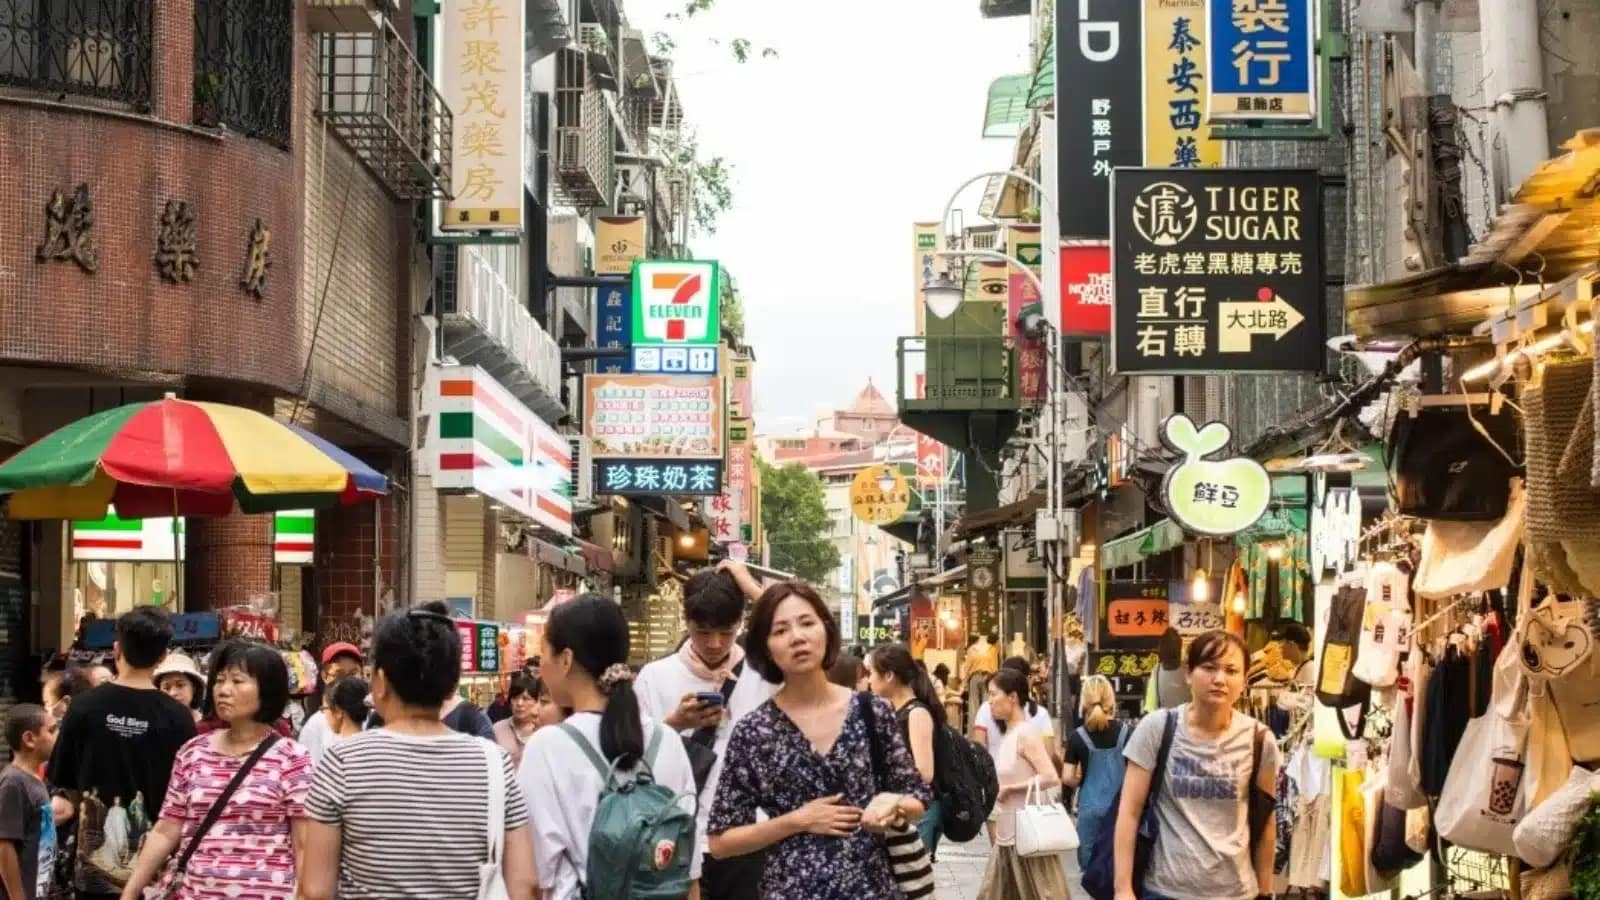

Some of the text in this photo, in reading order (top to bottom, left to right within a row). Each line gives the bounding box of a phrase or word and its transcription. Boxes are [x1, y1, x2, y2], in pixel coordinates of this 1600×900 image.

[457, 0, 507, 202] 許聚茂藥房
[1151, 188, 1182, 235] 虎
[1204, 187, 1301, 211] TIGER
[1205, 216, 1301, 241] SUGAR
[1134, 252, 1302, 275] 老虎堂黑糖專売
[1069, 284, 1112, 296] NORTH
[1088, 273, 1112, 285] THE
[1137, 286, 1207, 318] 直行
[1226, 309, 1289, 329] 大北路
[1136, 325, 1207, 357] 右轉
[606, 464, 716, 490] 珍珠奶茶
[1191, 481, 1240, 509] 鮮豆
[106, 713, 126, 725] God
